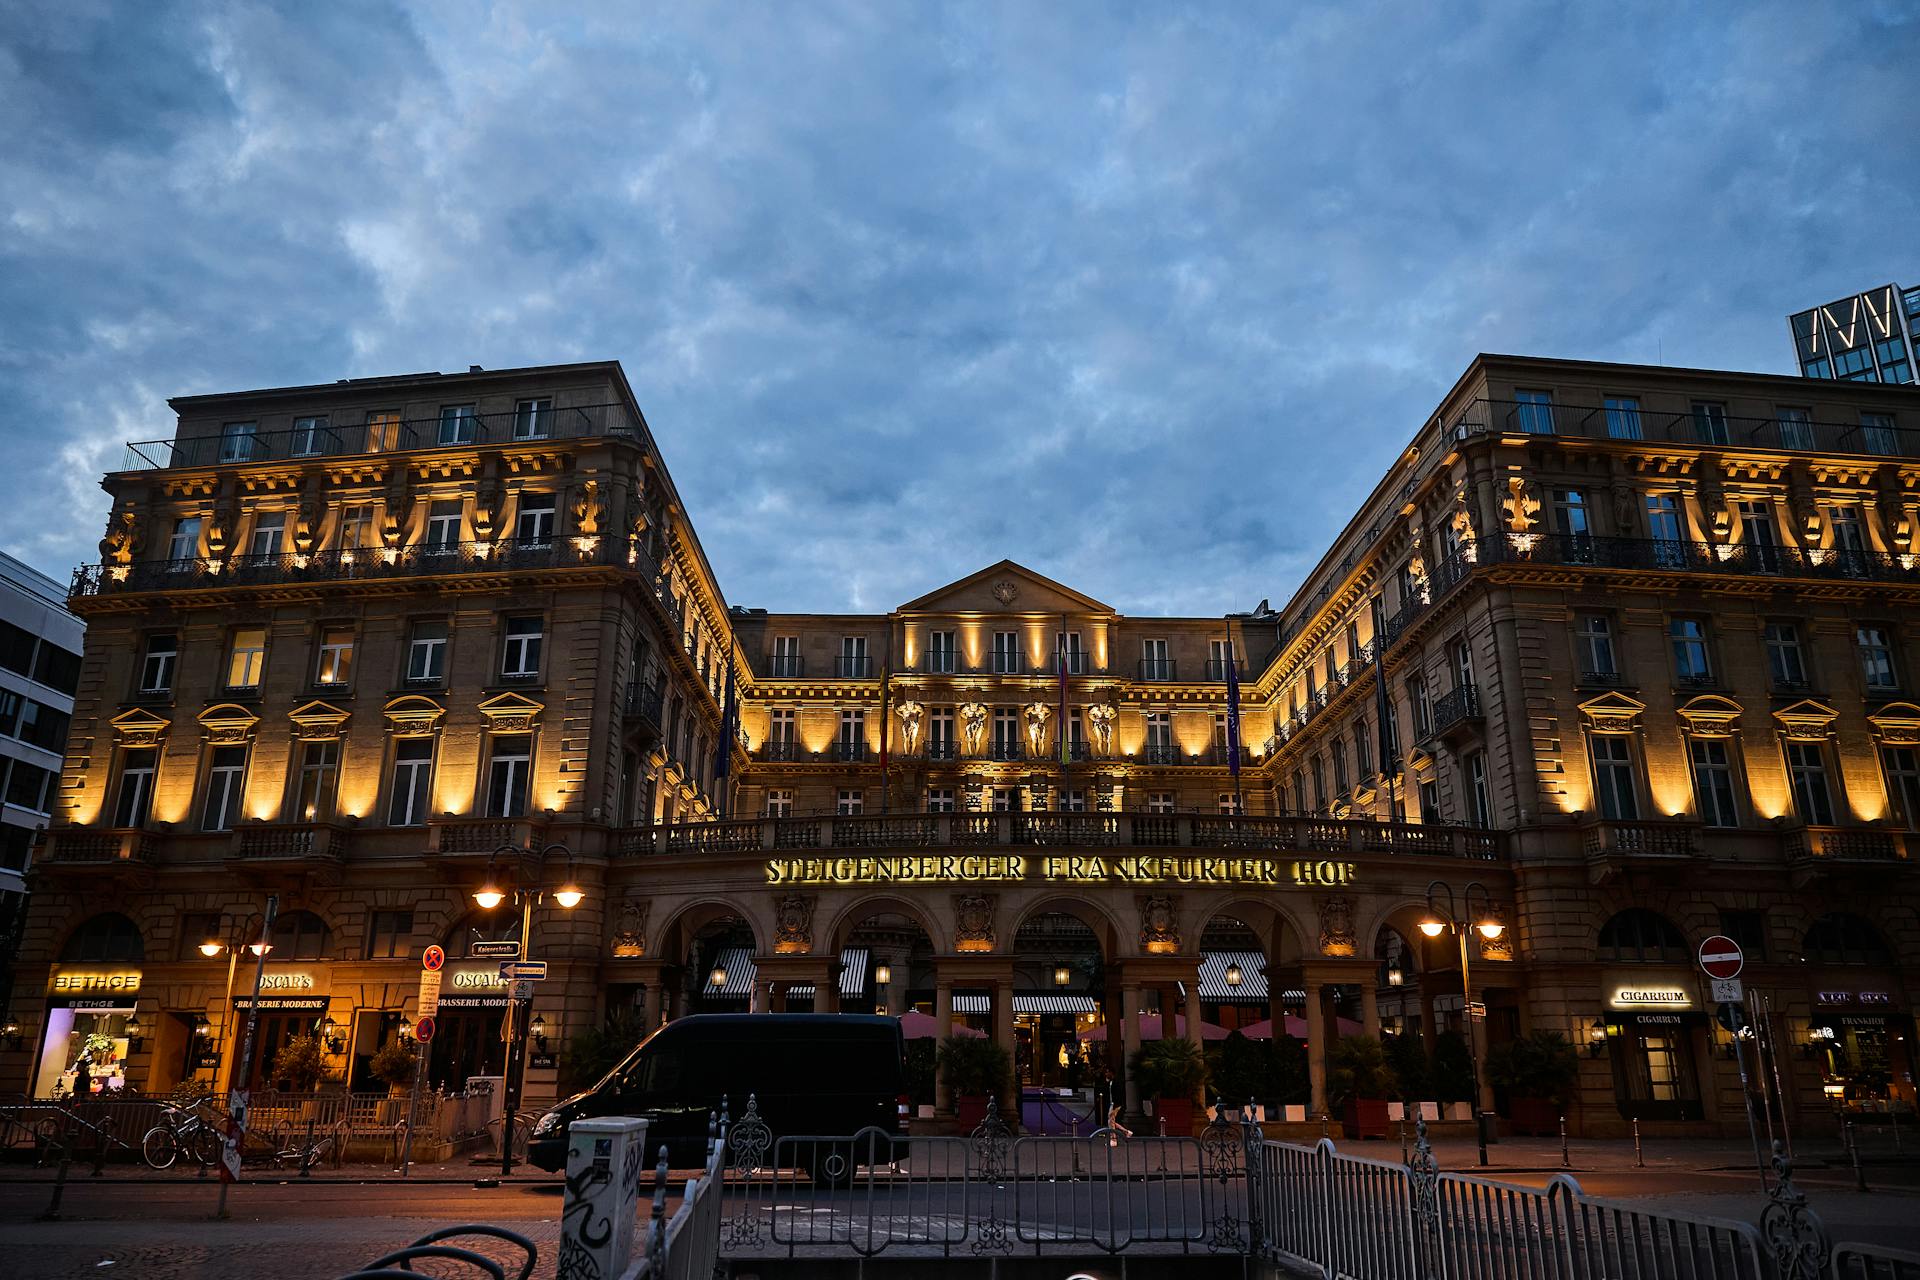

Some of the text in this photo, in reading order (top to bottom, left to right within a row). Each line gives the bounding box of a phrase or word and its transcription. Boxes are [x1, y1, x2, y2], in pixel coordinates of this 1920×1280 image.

[767, 855, 1356, 884] STEIGENBERGER FRANKFURTER HOF
[55, 976, 138, 988] BETHGE
[1620, 991, 1685, 1001] CIGARRUM
[69, 1000, 115, 1008] BETHGE
[237, 1000, 322, 1008] BRASERIE MODERNE
[1637, 1015, 1681, 1024] CIGARRUM
